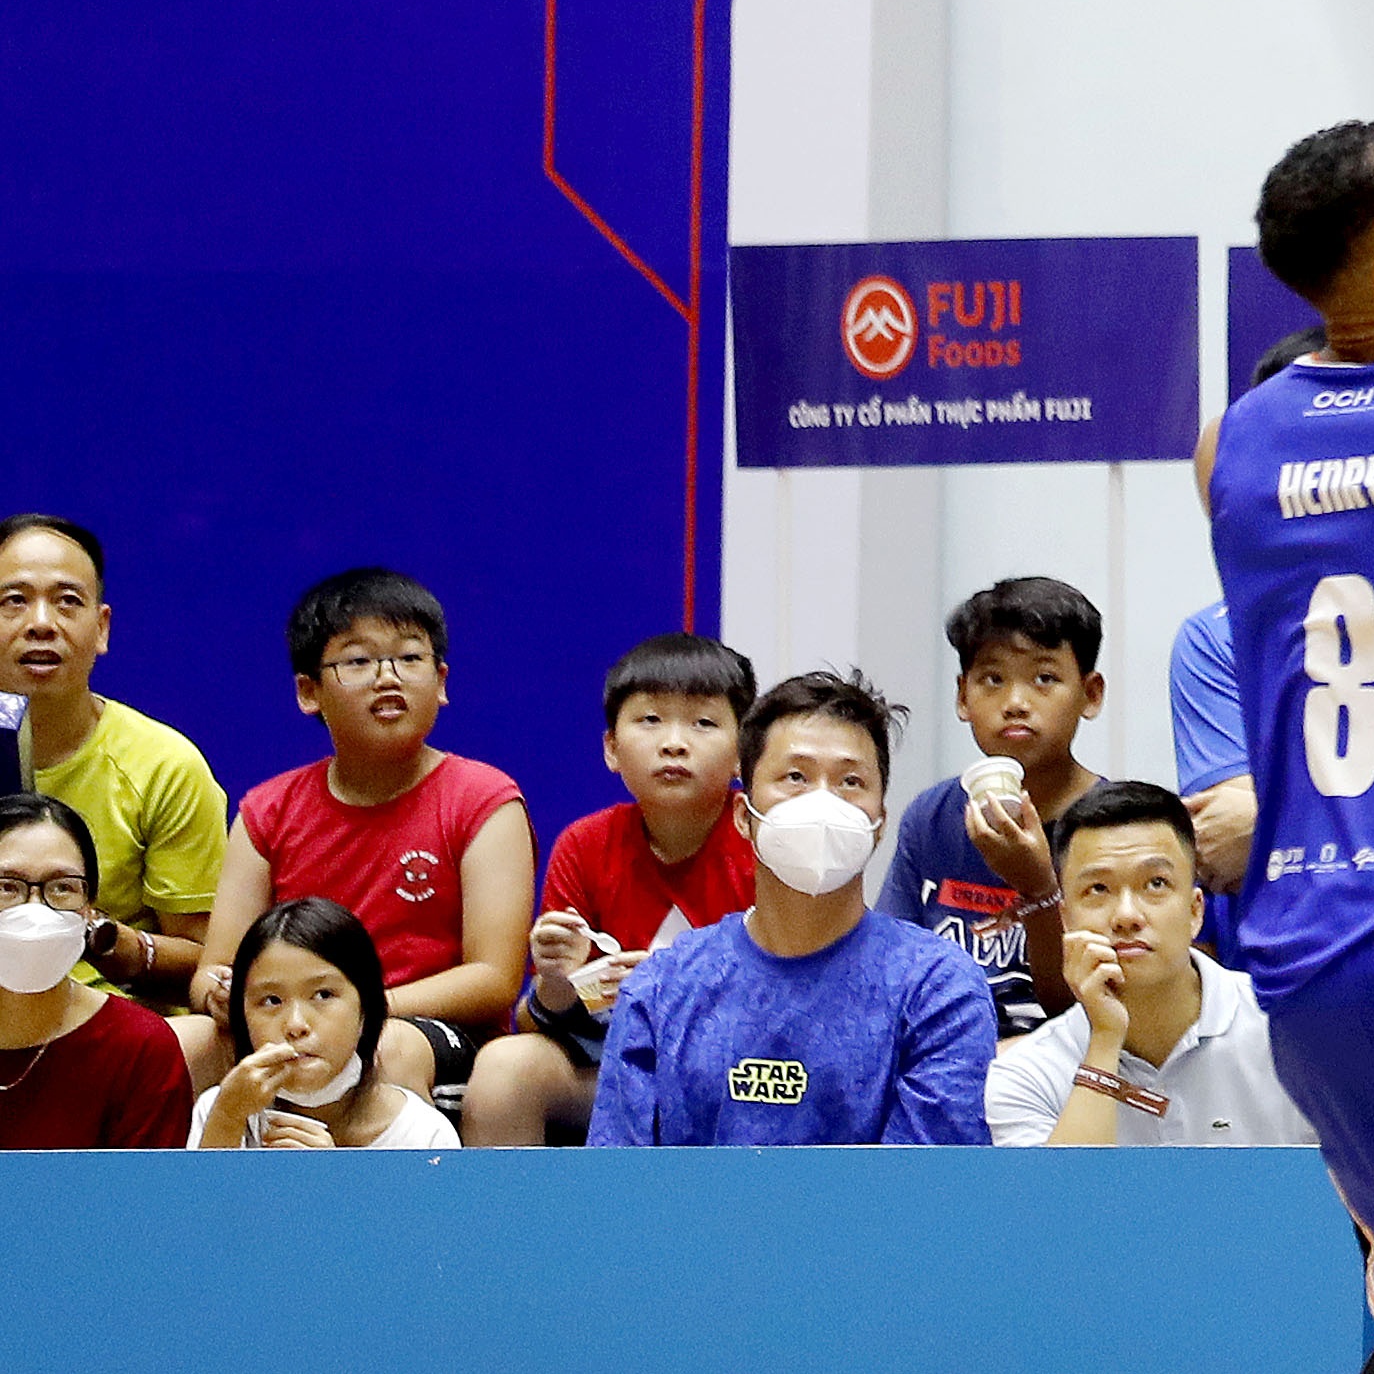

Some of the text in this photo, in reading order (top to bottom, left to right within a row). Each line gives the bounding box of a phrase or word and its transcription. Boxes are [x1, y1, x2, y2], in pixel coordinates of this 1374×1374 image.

[927, 280, 1022, 332] FUJI
[732, 1063, 803, 1082] STAR
[732, 1080, 803, 1099] WARS
